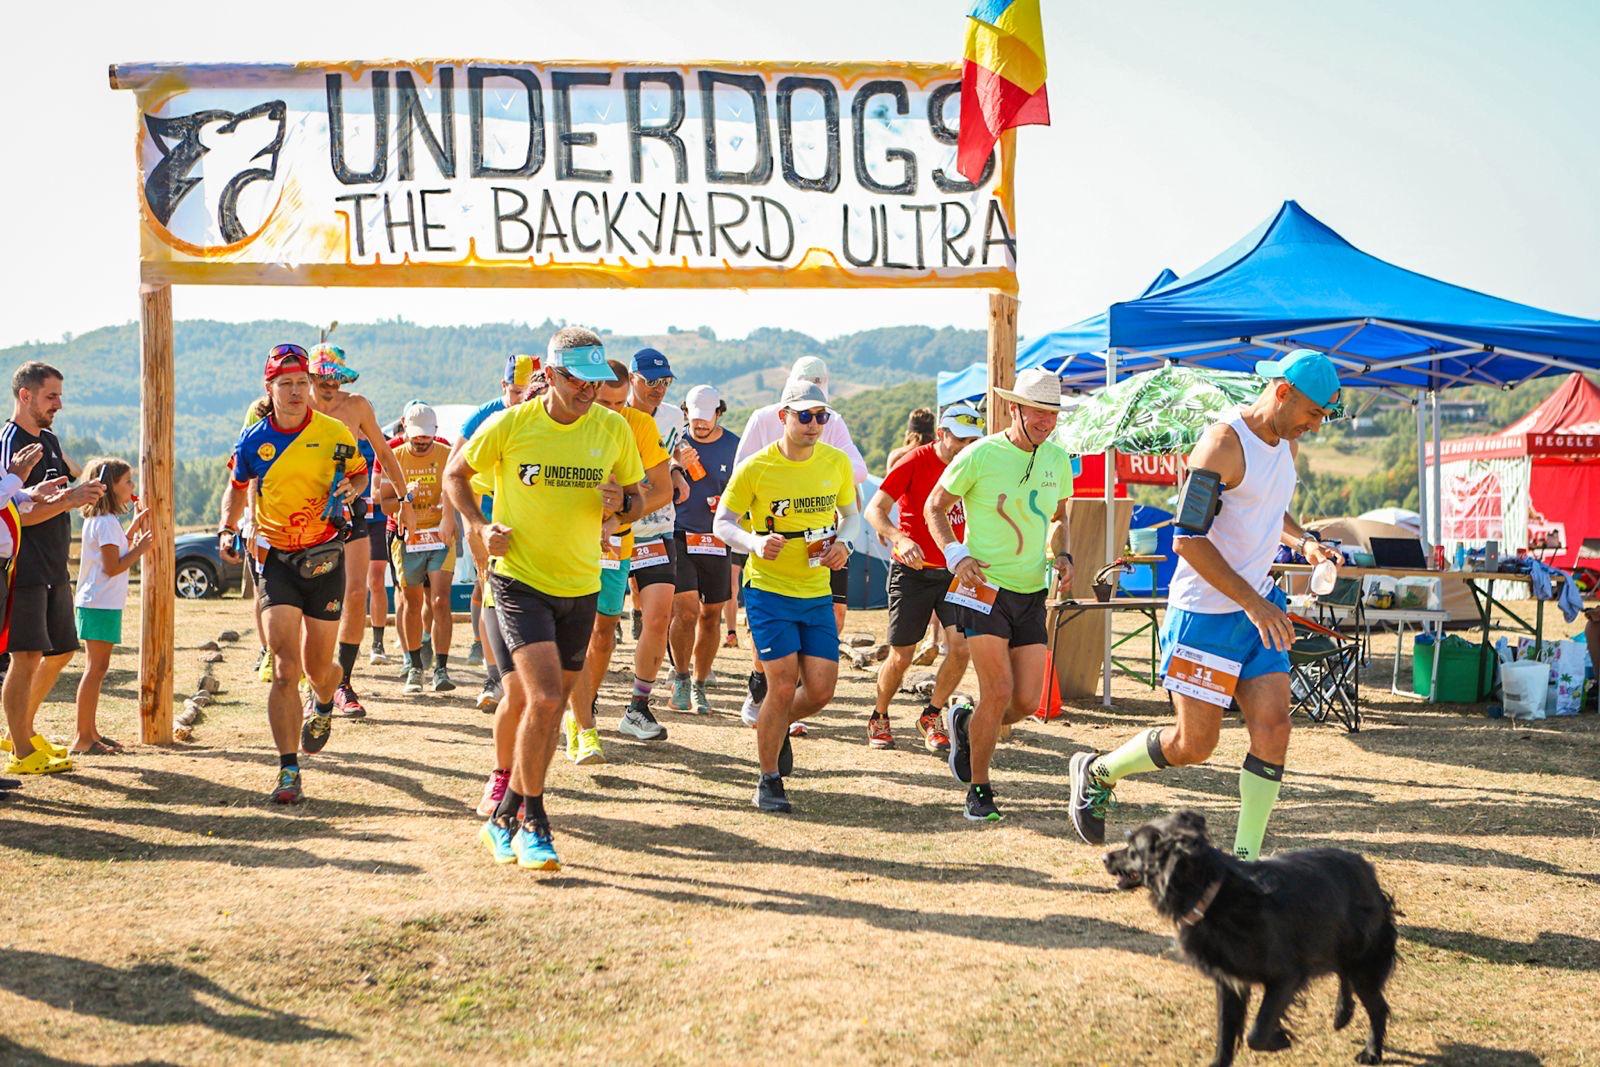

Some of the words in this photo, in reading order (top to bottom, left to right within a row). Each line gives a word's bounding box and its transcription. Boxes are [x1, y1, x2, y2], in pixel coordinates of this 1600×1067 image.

[326, 67, 995, 196] UNDERDOGS
[335, 187, 456, 257] THE
[491, 186, 795, 262] BACKYARD
[843, 199, 1017, 270] ULTRA
[1535, 436, 1594, 447] REGELE
[544, 465, 604, 481] UNDERDOGS
[544, 479, 555, 487] THE
[556, 479, 586, 488] BACKYARD
[586, 481, 601, 489] ULTR
[1193, 667, 1213, 683] 11
